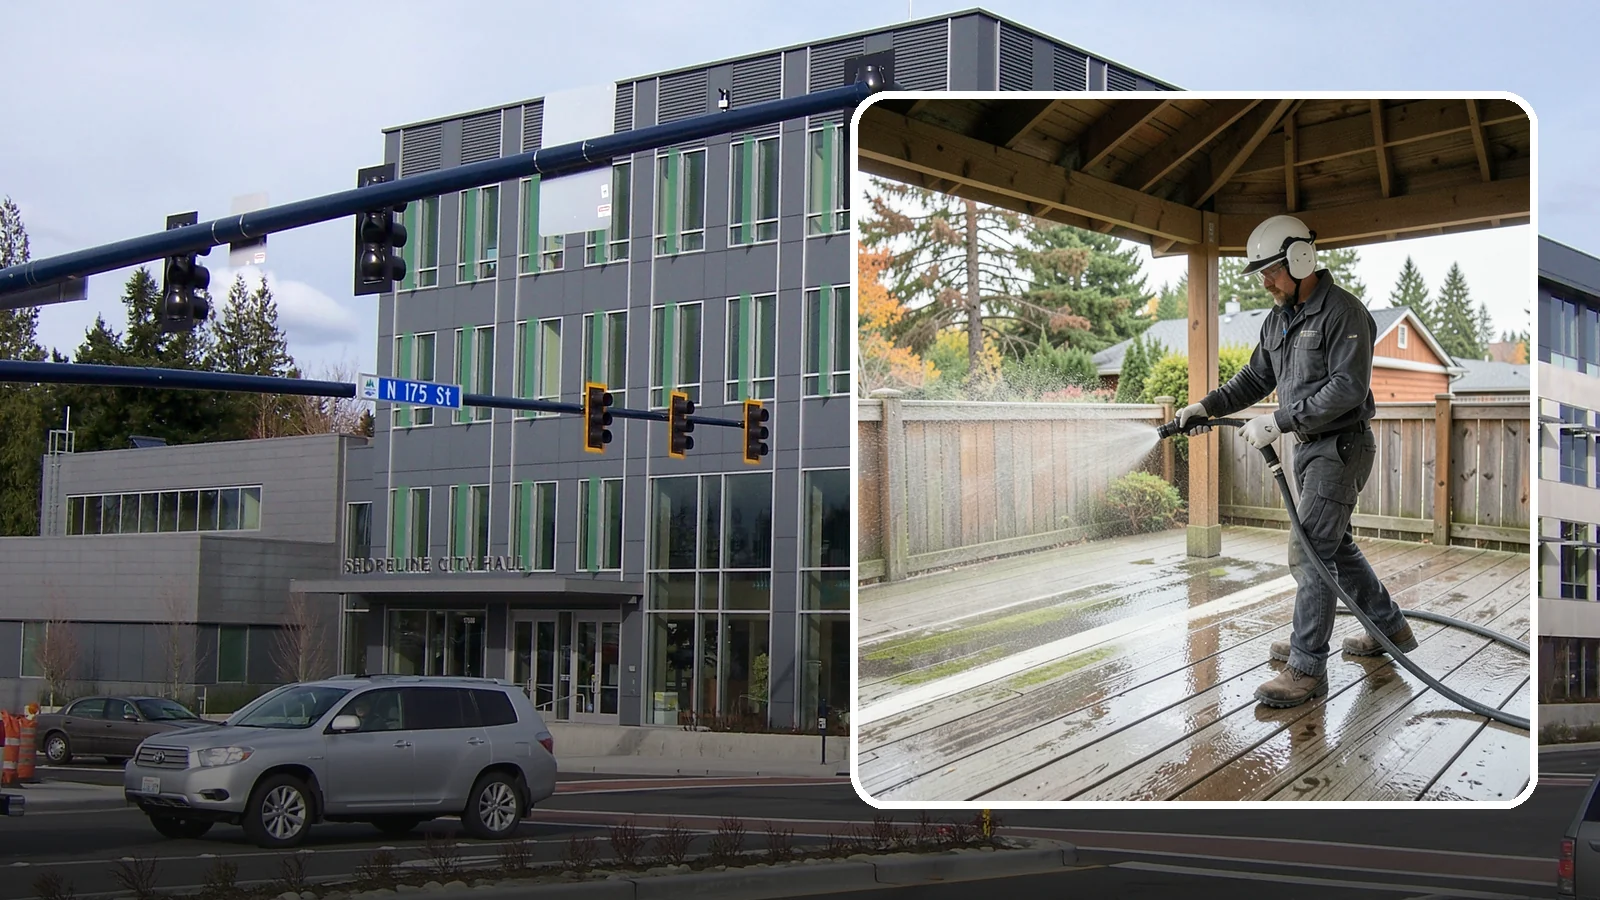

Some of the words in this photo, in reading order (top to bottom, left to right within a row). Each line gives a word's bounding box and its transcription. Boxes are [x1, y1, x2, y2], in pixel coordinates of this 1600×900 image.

[387, 380, 396, 400] N
[405, 382, 427, 403] 175
[436, 386, 452, 406] St
[344, 556, 432, 574] SHORELINE
[438, 556, 475, 572] CITY
[483, 555, 525, 571] HALL
